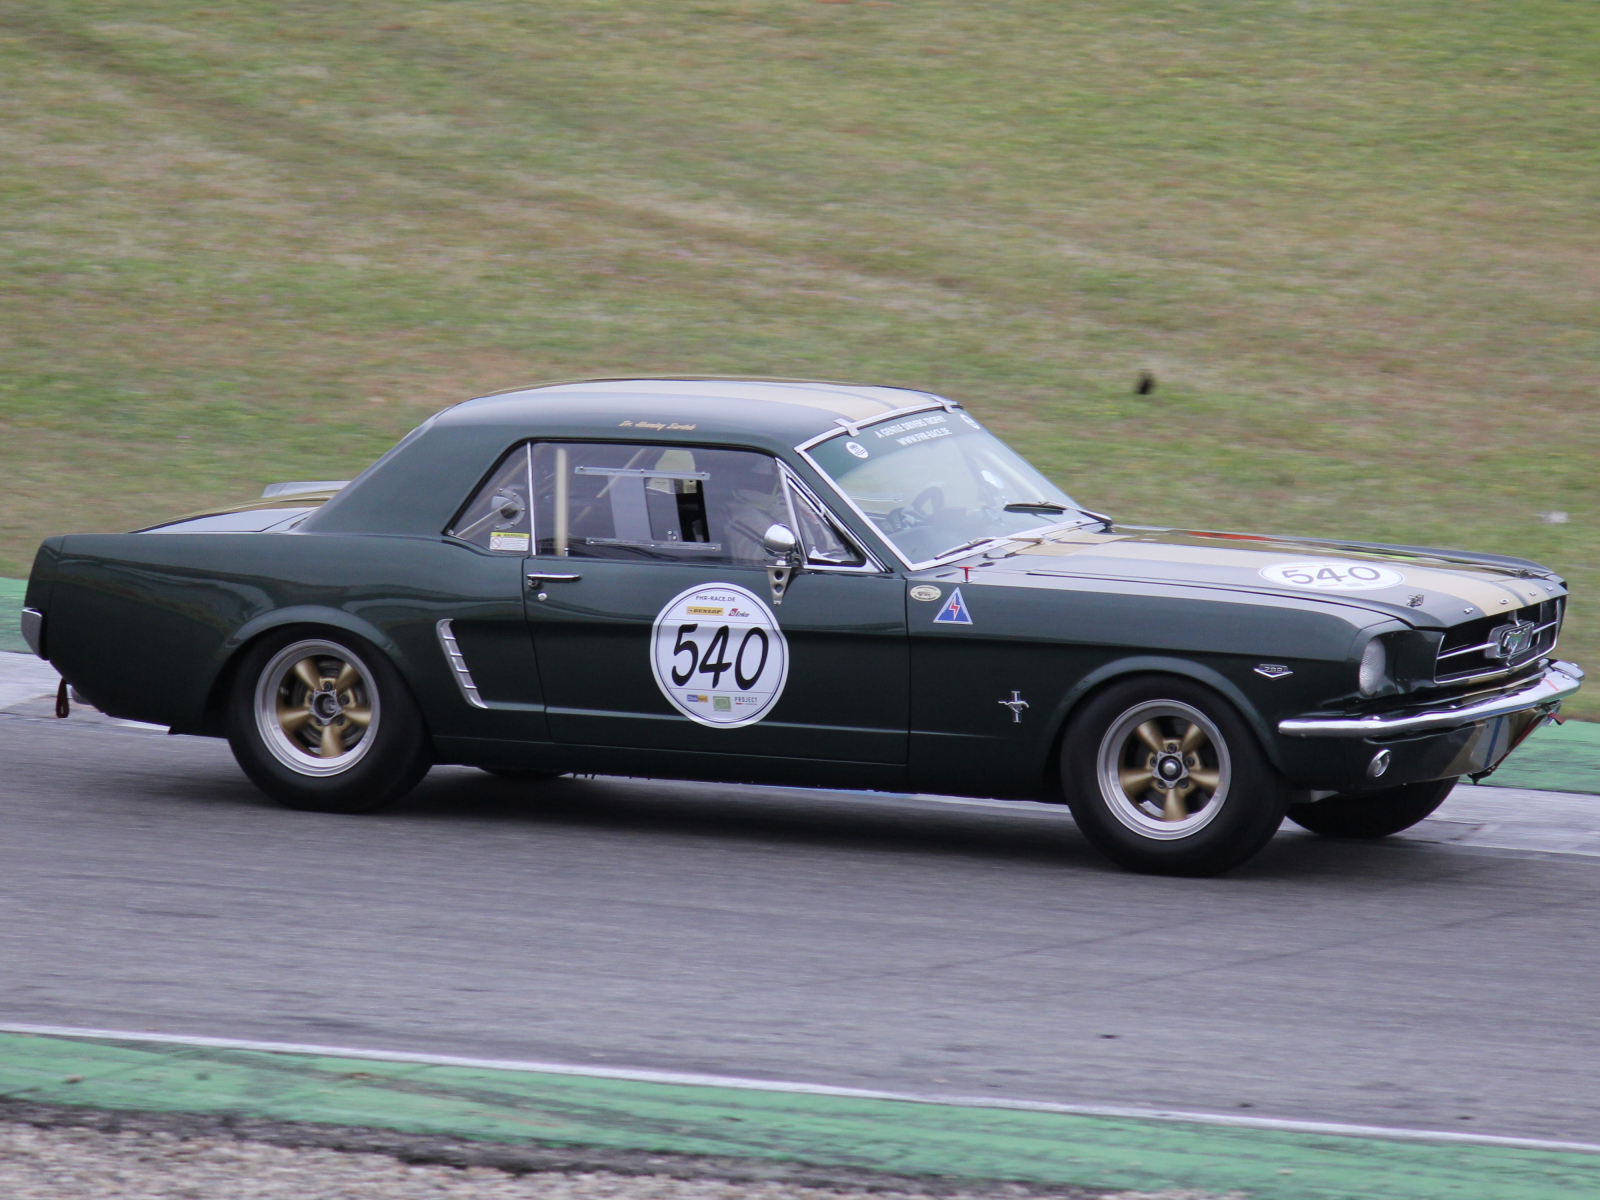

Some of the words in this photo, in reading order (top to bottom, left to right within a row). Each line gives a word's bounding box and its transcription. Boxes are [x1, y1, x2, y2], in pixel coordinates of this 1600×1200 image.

[1281, 565, 1381, 585] 540
[695, 595, 736, 603] FHR-RACE.DE
[671, 623, 769, 691] 540
